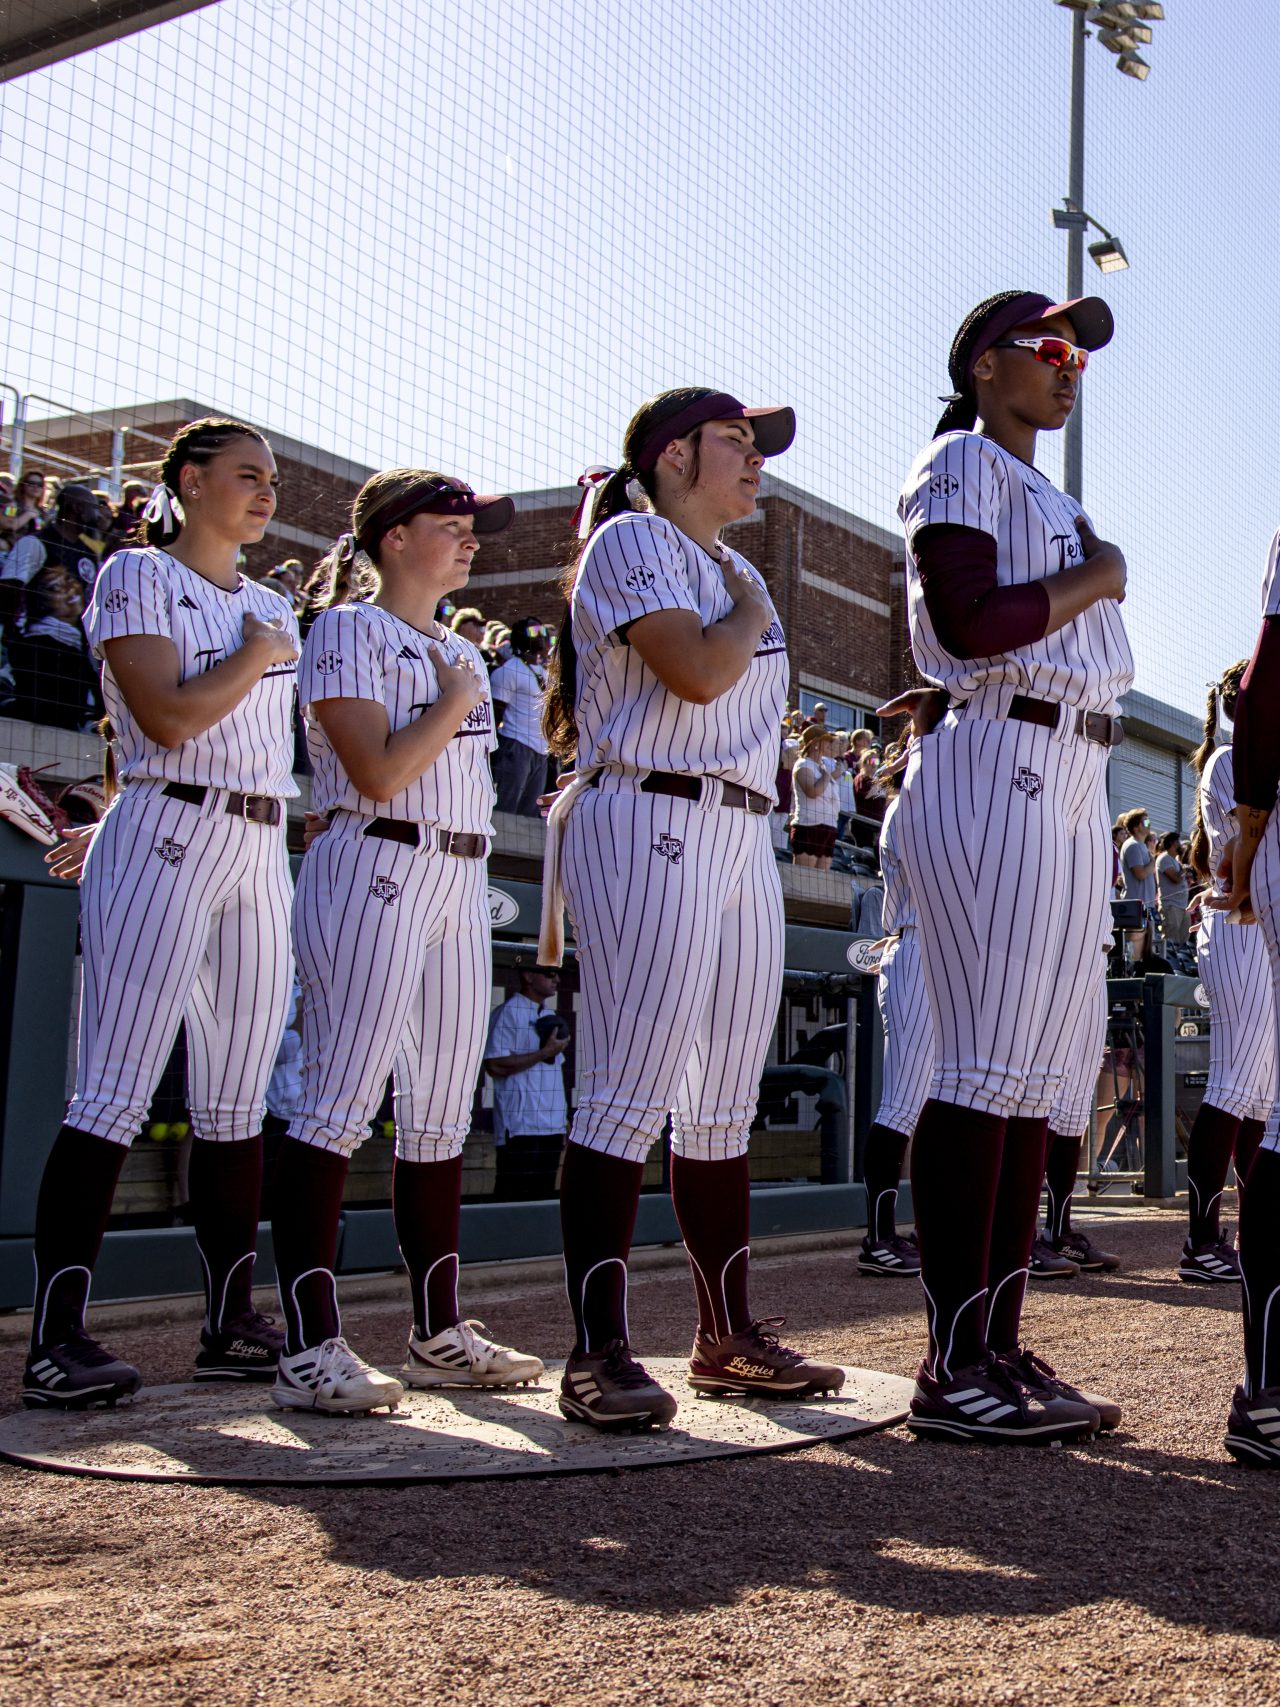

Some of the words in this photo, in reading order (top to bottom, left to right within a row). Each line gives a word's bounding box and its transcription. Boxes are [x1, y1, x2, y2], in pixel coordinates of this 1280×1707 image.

[930, 474, 958, 498] SEC
[626, 566, 654, 590] SEC
[106, 590, 128, 613] SEC
[317, 651, 342, 674] SEC
[231, 1339, 268, 1359] Aggies
[730, 1356, 775, 1378] Aggies
